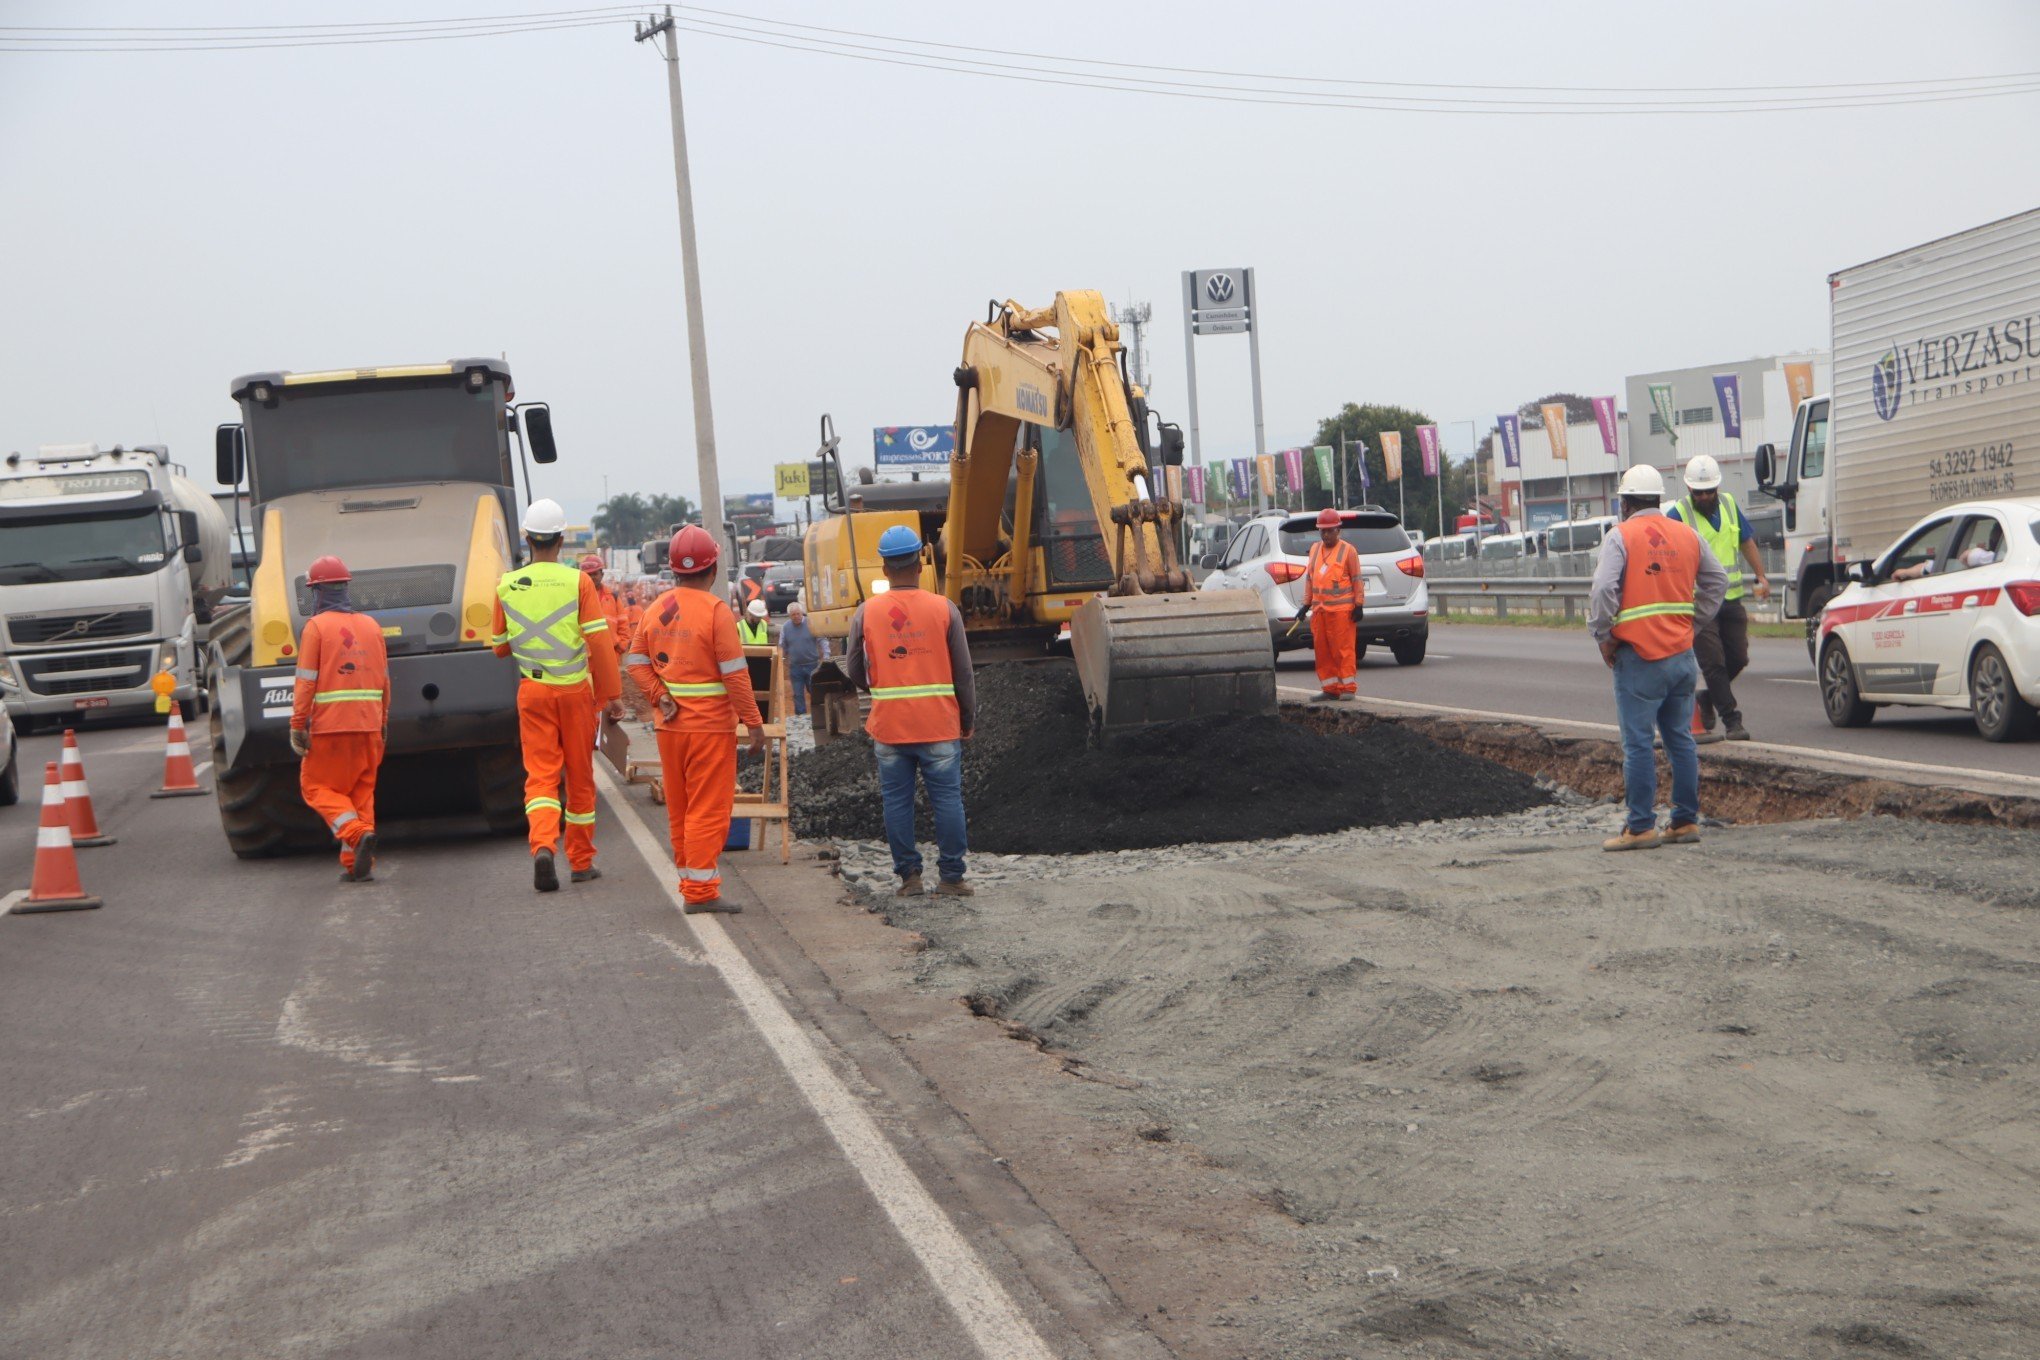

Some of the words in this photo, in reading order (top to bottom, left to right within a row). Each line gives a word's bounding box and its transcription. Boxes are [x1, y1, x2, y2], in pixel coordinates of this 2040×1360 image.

[1016, 386, 1047, 417] KOMATSU
[1723, 386, 1739, 428] PNEUS
[1423, 429, 1436, 473] SERVIÇOS
[1981, 443, 2014, 471] 1942
[59, 476, 138, 489] TROTTER
[1930, 480, 1958, 501] FLORES
[1960, 479, 1970, 498] DA
[1972, 476, 1998, 497] CUNHA
[2004, 472, 2015, 492] RS
